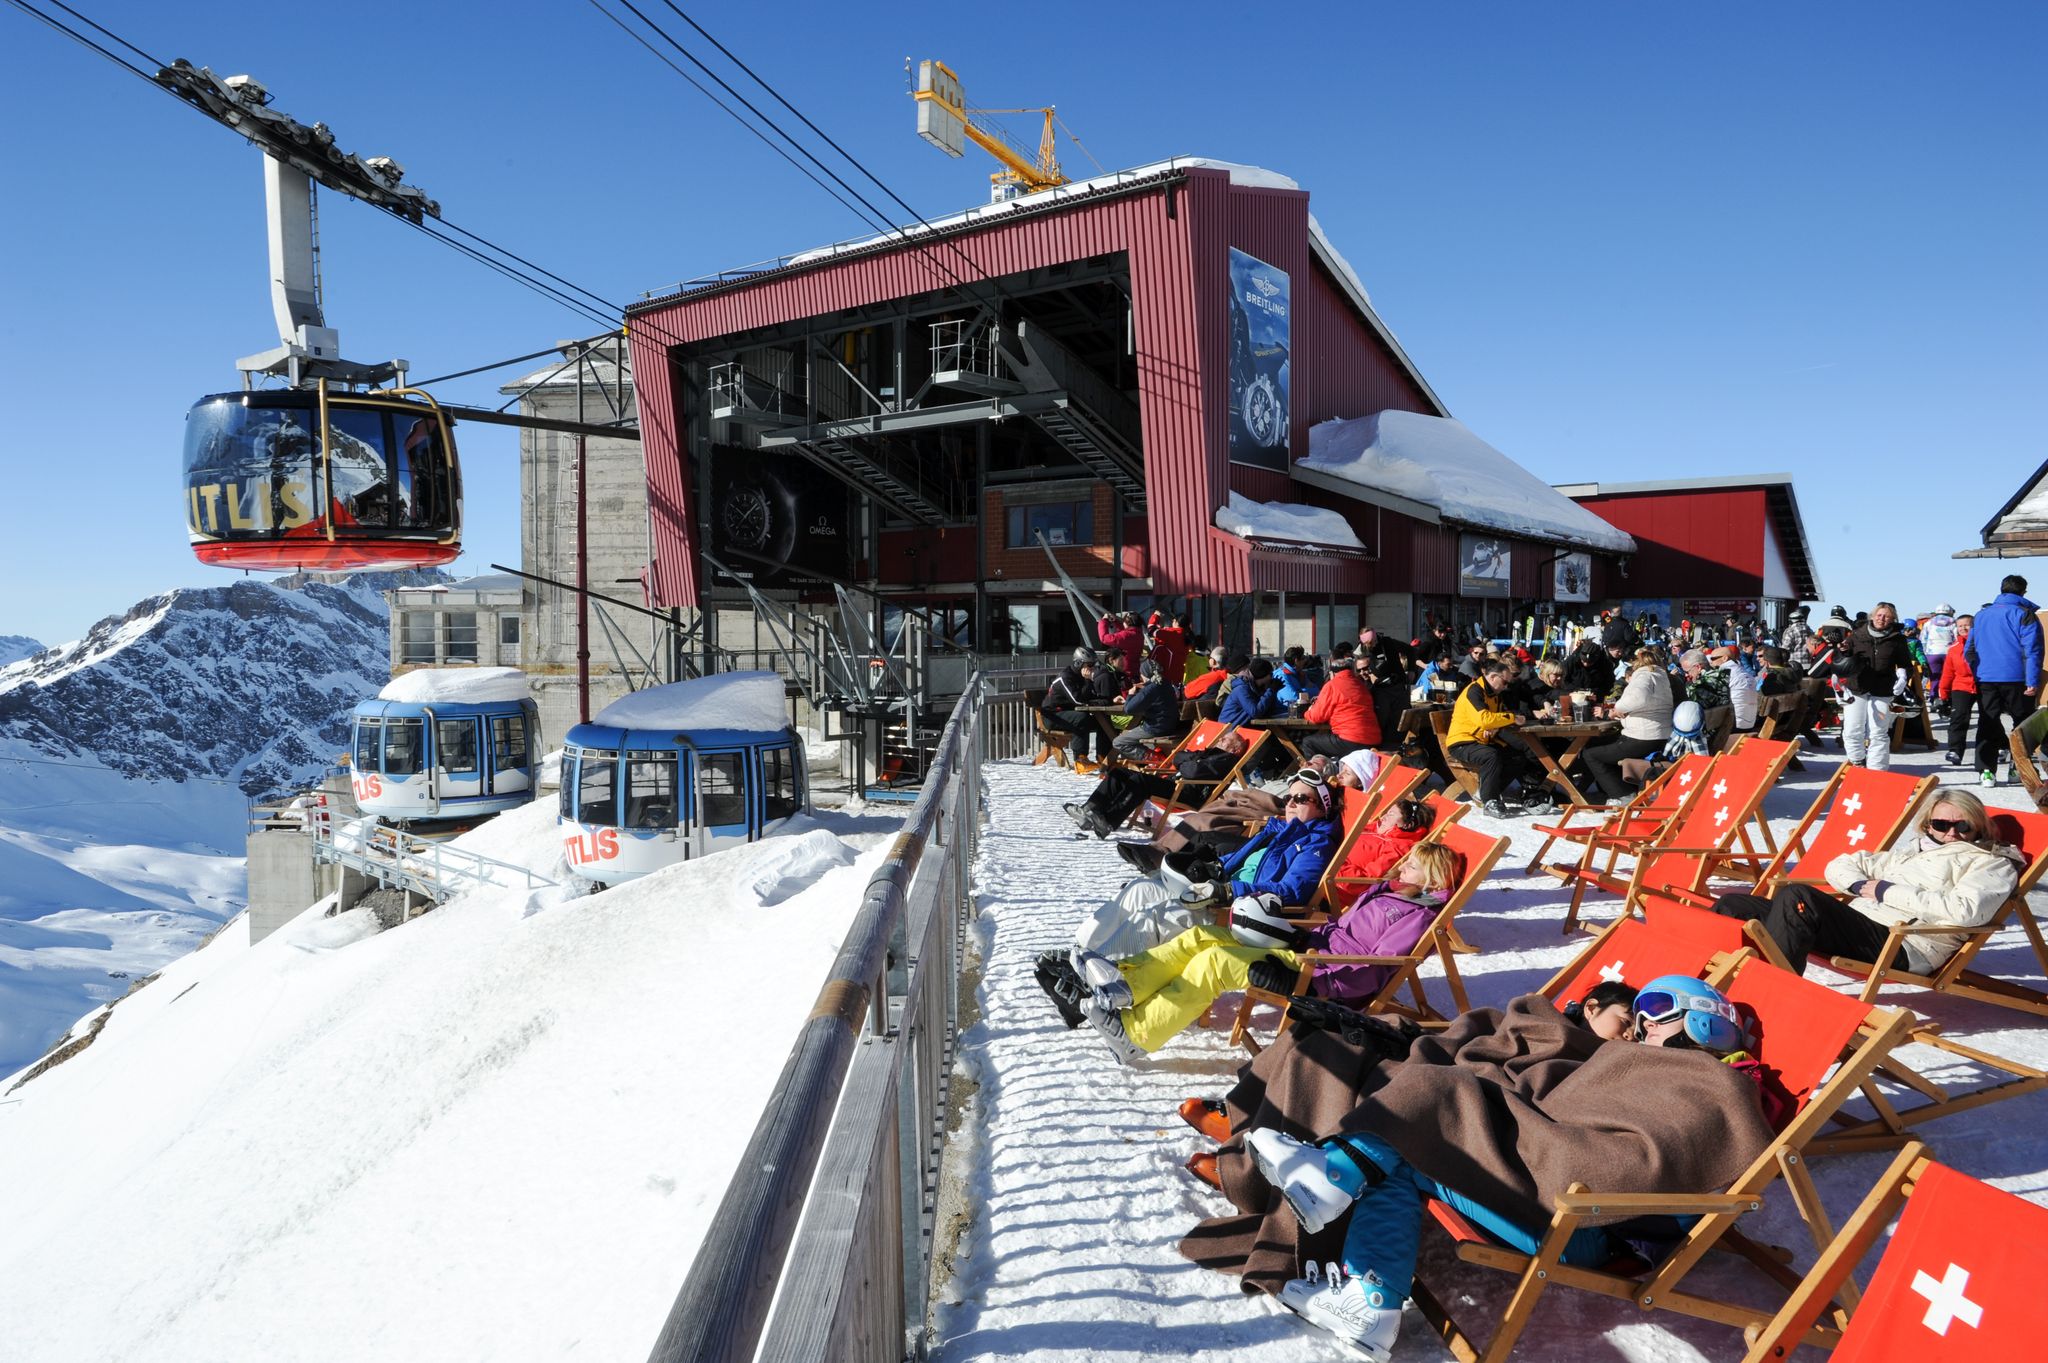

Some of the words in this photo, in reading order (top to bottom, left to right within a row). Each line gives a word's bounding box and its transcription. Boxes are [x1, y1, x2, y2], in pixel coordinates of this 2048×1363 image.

[1246, 291, 1285, 316] BREITLING
[185, 483, 309, 533] ITLIS
[809, 525, 837, 536] OMEGA
